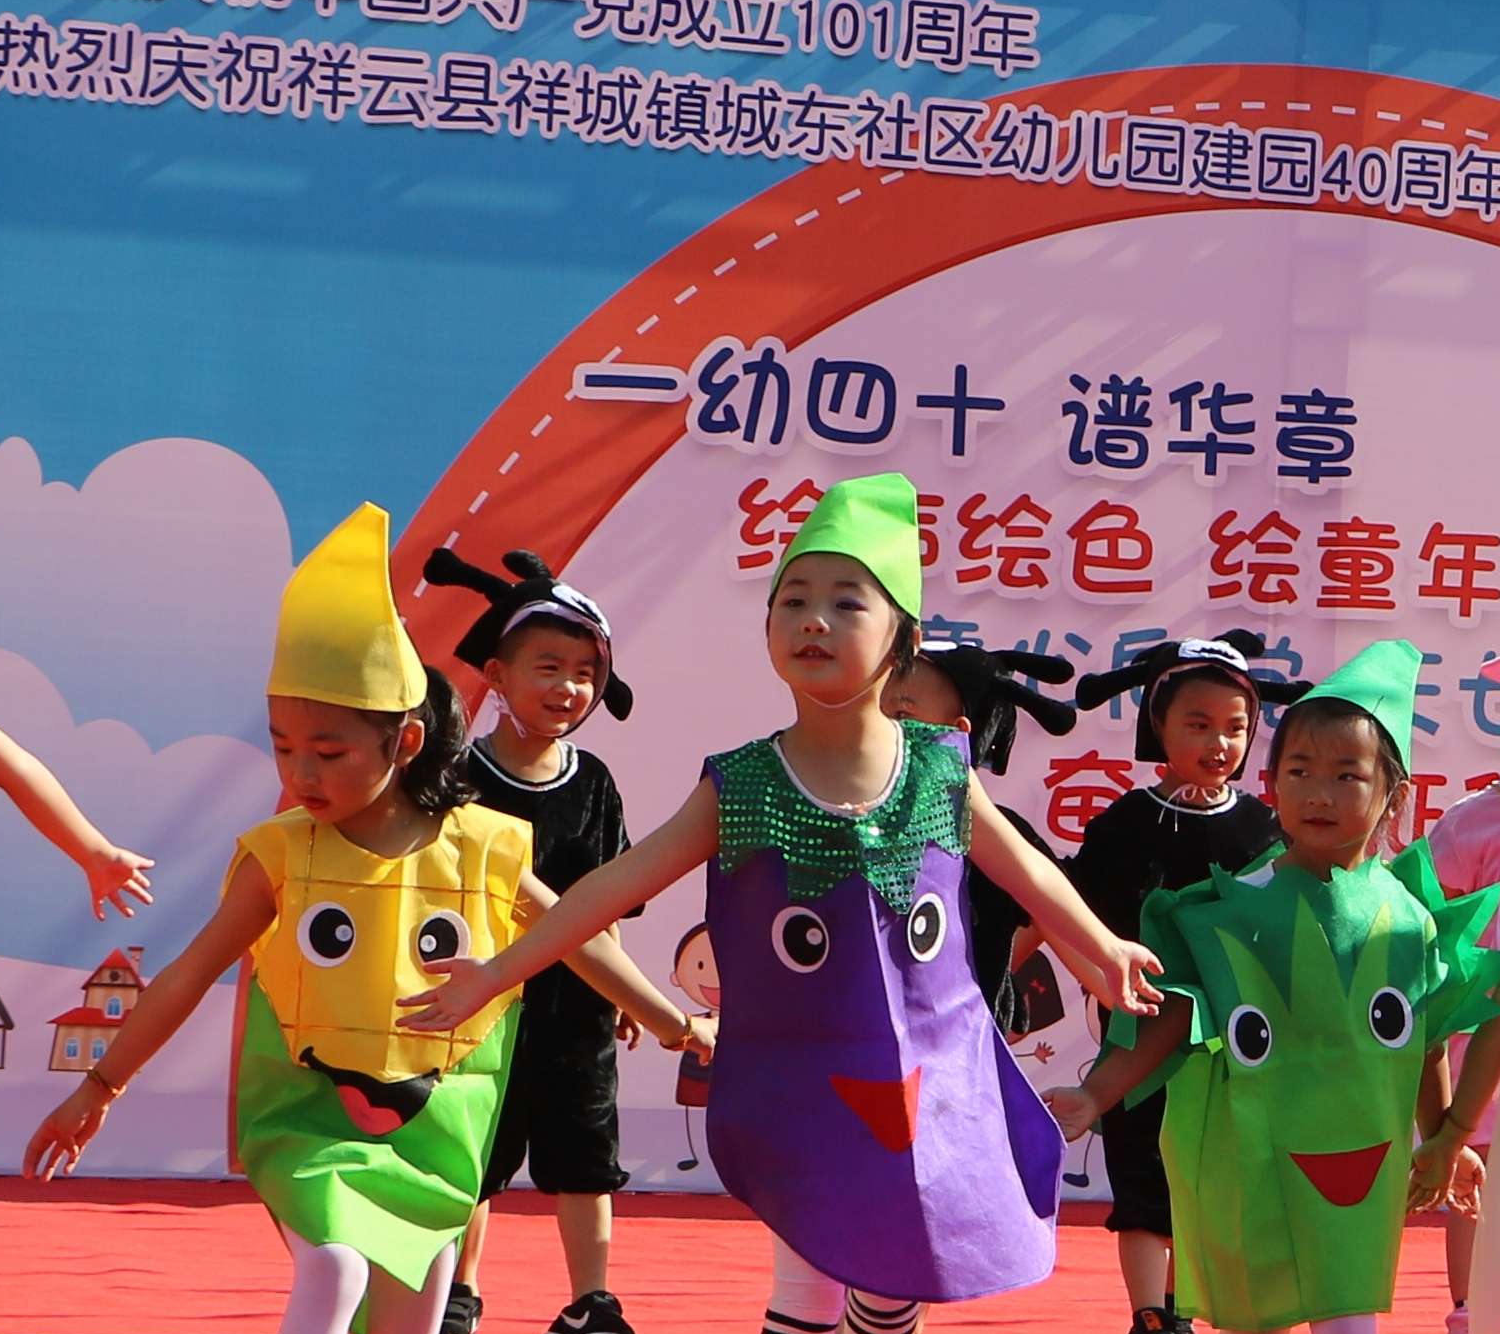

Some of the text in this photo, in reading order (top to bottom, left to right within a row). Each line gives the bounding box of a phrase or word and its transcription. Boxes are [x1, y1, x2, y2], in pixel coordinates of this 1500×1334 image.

[584, 347, 1358, 484] 一幼四十 谱华章
